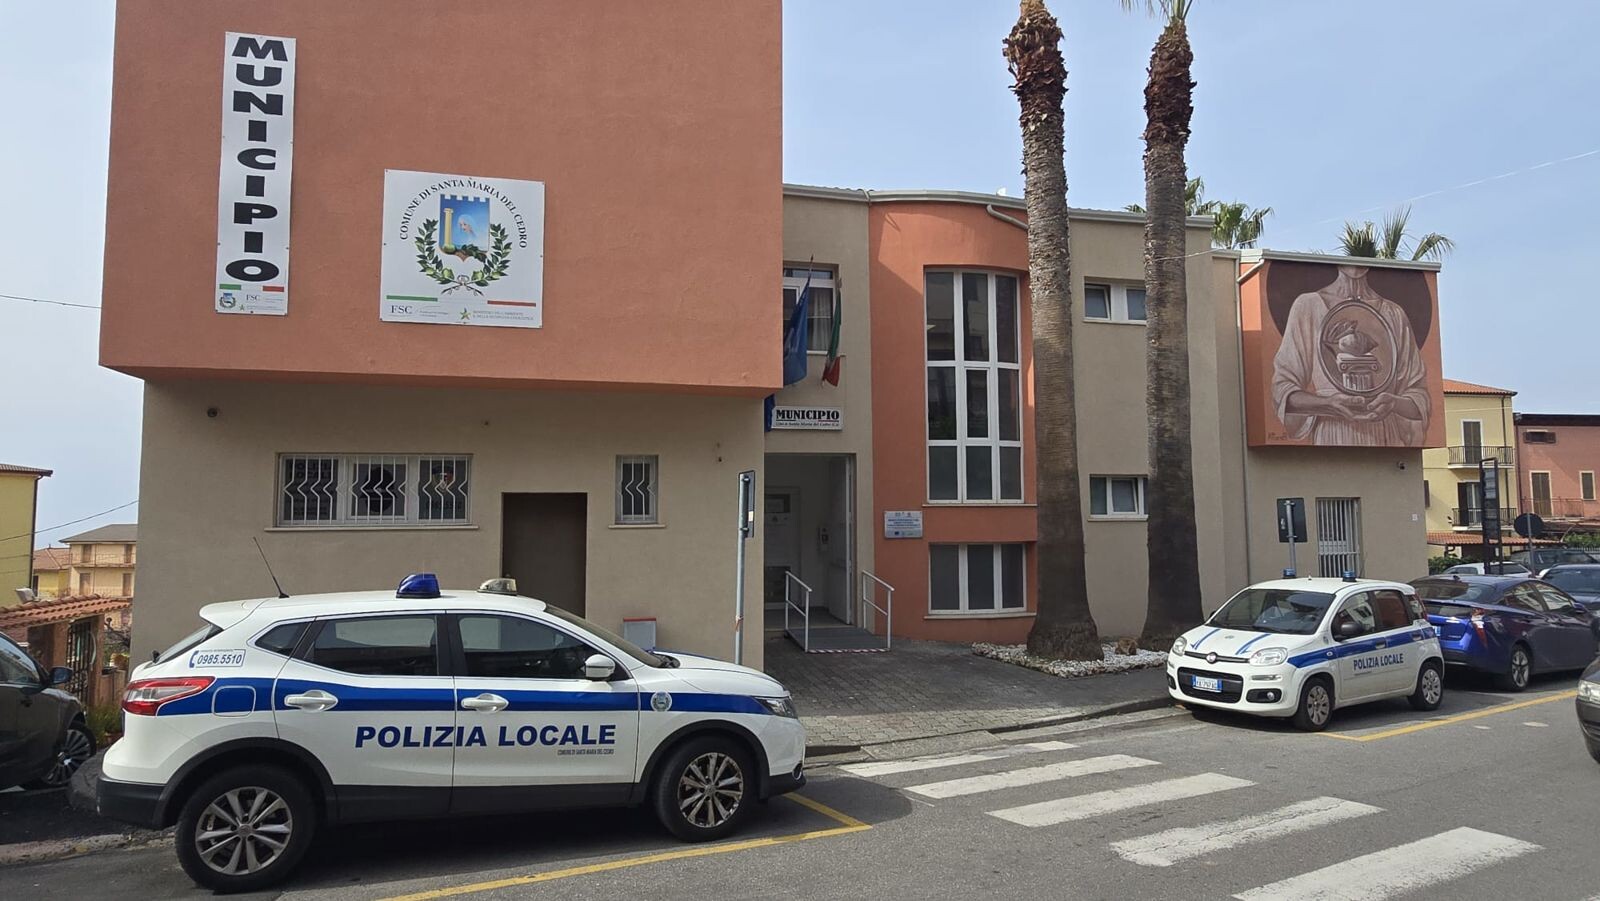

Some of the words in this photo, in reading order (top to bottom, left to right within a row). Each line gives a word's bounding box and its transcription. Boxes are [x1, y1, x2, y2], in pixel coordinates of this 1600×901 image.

[225, 36, 288, 282] MUNICIPIO
[400, 198, 421, 240] COMUNE
[418, 189, 431, 200] DI
[431, 179, 465, 193] SANTA
[467, 180, 500, 199] MARIA
[500, 195, 517, 214] DEL
[513, 214, 527, 248] CEDRO
[391, 305, 413, 314] FSC
[776, 409, 840, 420] MUNICIPIO
[197, 654, 242, 665] 0985.5510
[1353, 656, 1380, 670] POLIZIA
[1380, 653, 1404, 666] LOCALE
[355, 726, 487, 748] POLIZIA
[498, 725, 616, 746] LOCALE
